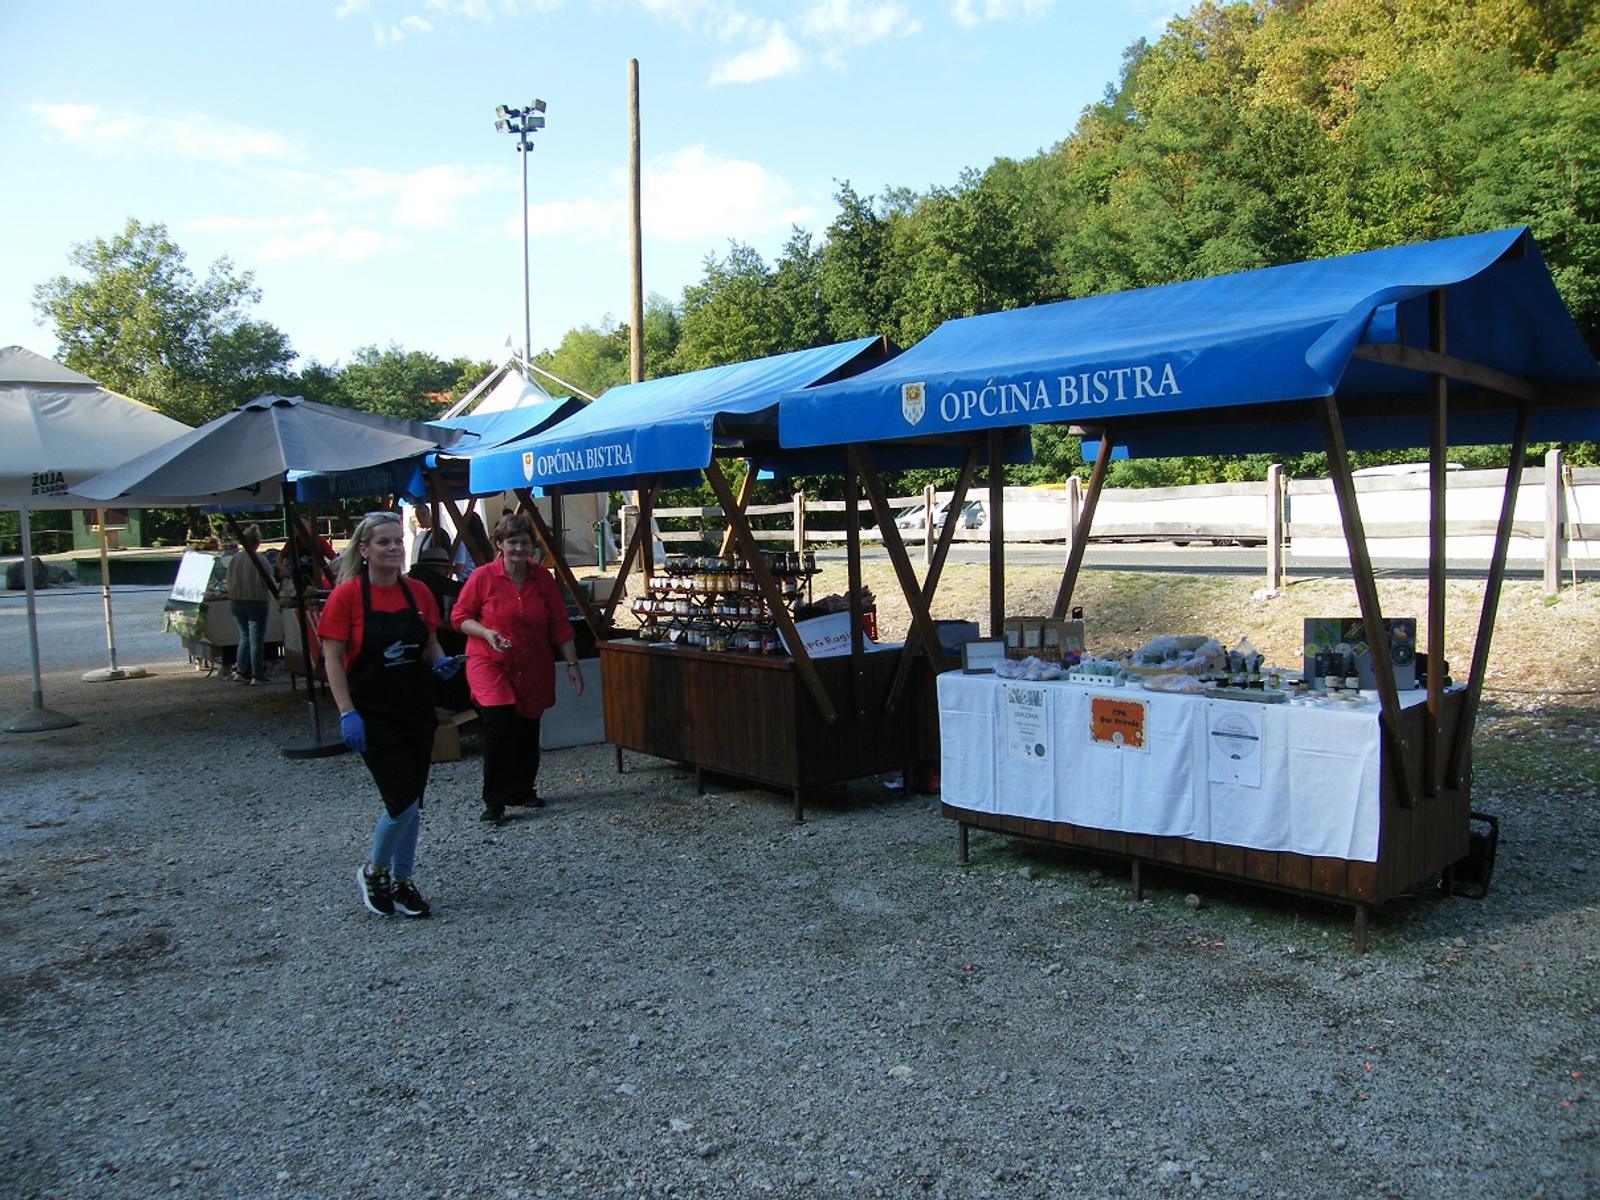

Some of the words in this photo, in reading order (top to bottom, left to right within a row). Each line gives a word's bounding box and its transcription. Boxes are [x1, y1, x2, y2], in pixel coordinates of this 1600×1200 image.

[940, 378, 1052, 422] OPĆINA
[1057, 363, 1182, 408] BISTRA
[537, 448, 585, 476] OPĆINA
[586, 443, 632, 469] BISTRA
[31, 471, 65, 487] ŽUJA
